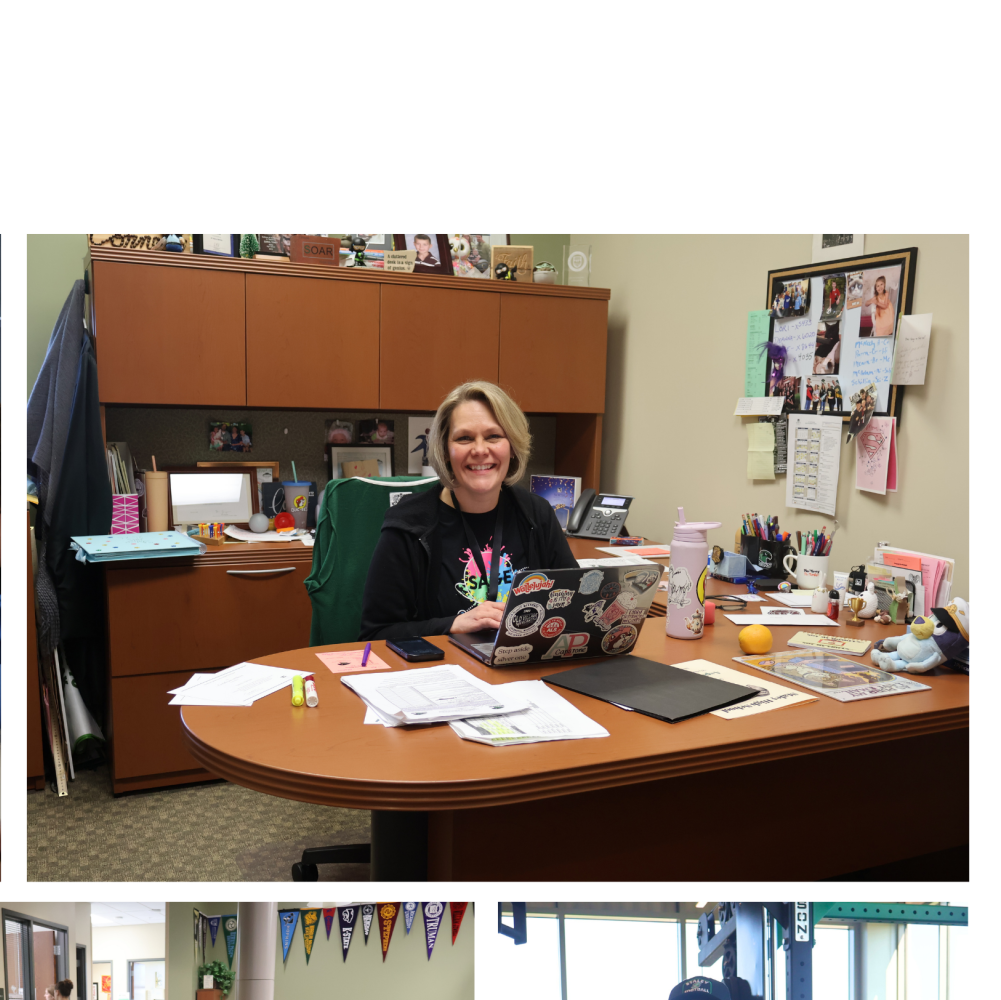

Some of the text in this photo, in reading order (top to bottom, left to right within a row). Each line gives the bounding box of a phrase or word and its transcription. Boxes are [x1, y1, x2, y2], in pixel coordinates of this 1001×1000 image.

[303, 244, 334, 256] SOAR
[498, 645, 530, 655] Step aside
[342, 927, 353, 950] K-STATE
[426, 917, 440, 949] TRUMAN
